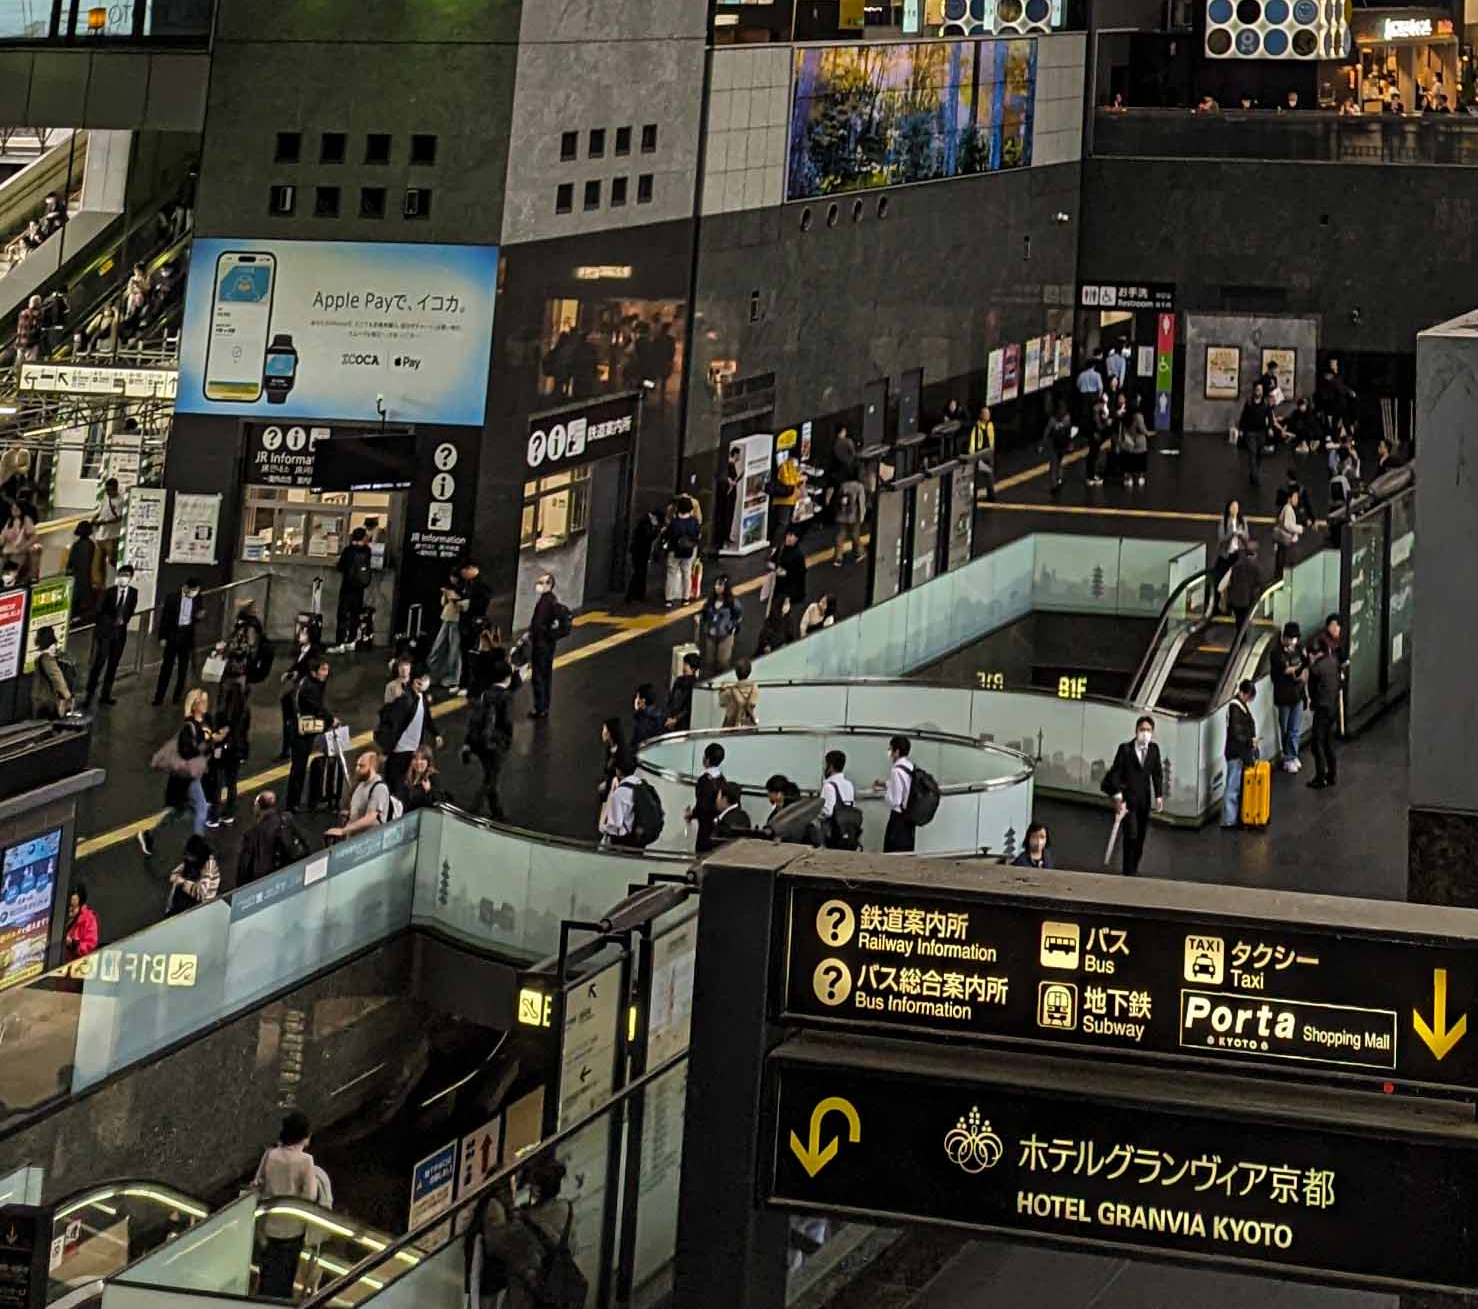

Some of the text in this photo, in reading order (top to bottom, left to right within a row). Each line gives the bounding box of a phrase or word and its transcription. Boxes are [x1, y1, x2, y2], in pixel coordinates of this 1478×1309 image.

[312, 291, 360, 311] Apple
[341, 353, 421, 370] ICOCA Pay
[860, 903, 969, 940] 鉄道案内所
[858, 932, 997, 963] Railway Information
[1086, 927, 1130, 956] バス
[1188, 937, 1221, 953] TAXI
[1231, 940, 1319, 971] タクシー
[1085, 955, 1115, 975] Bus
[1231, 969, 1264, 990] Taxi
[857, 963, 1009, 1005] バス総合案内所
[856, 991, 972, 1021] Bus Information
[1084, 986, 1152, 1020] 地下鉄
[1083, 1015, 1146, 1042] Subway
[1184, 995, 1390, 1051] Porta Shopping Mall
[1218, 1036, 1258, 1051] KYOTO
[1018, 1133, 1335, 1209] ホテルグランヴィア京都
[1017, 1190, 1293, 1250] HOTEL GRANVIA KYOTO
